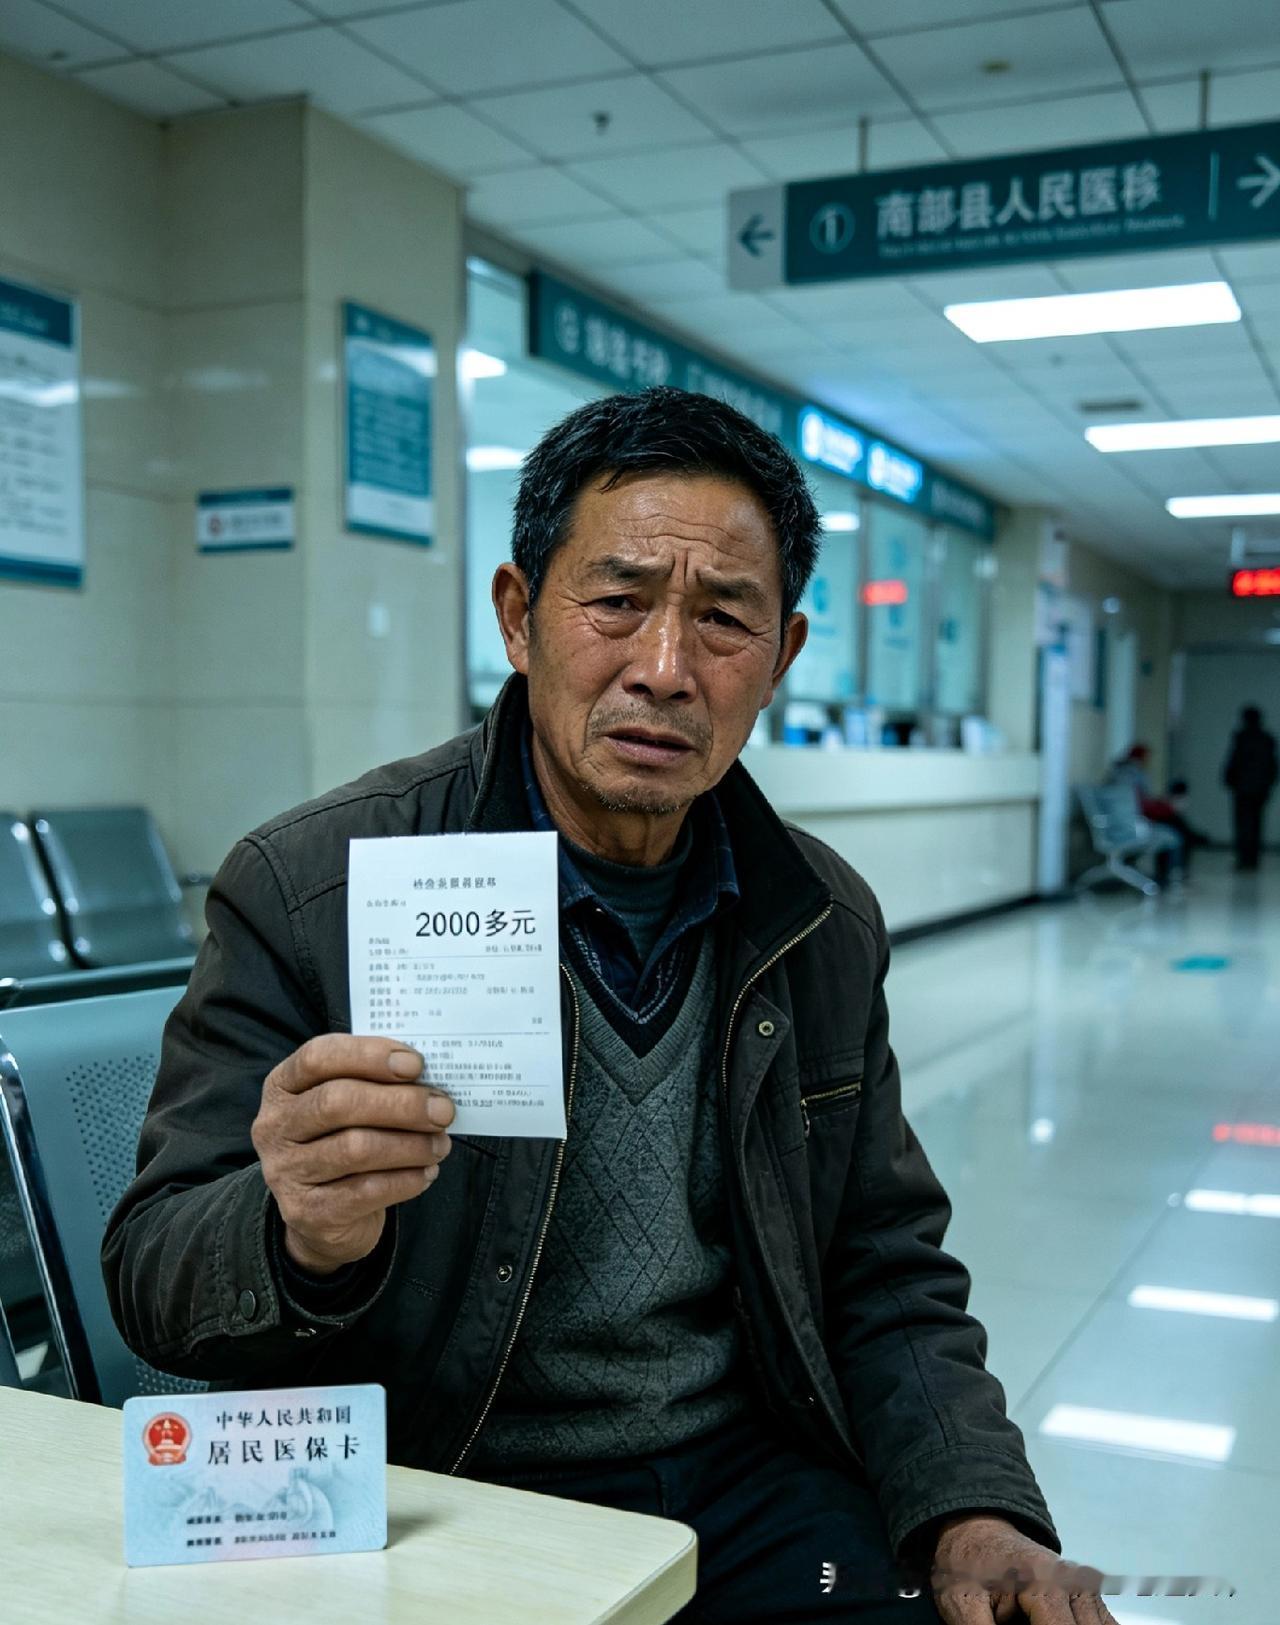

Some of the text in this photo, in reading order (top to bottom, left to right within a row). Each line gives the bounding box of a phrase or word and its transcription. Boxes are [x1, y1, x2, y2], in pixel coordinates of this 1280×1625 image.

[416, 909, 536, 937] 2000多元
[216, 1405, 351, 1430] 中华人民共和国
[208, 1434, 360, 1465] 居民医保卡
